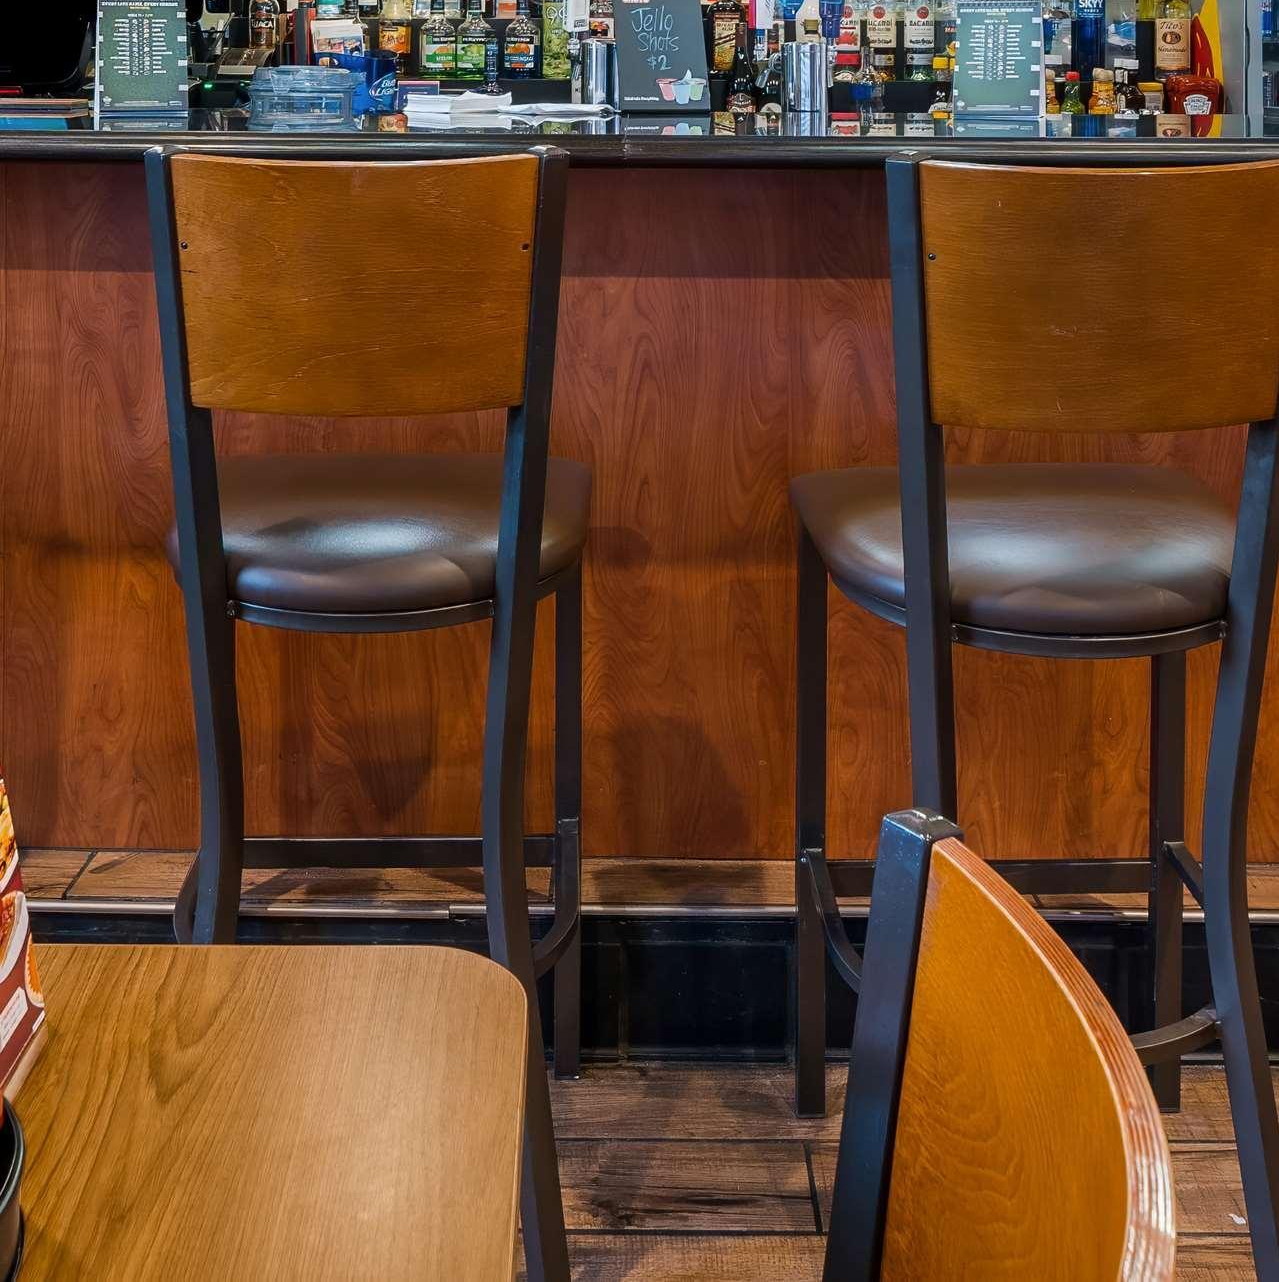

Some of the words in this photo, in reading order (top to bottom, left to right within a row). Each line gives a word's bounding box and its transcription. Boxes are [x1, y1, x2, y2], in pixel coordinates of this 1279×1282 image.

[630, 5, 674, 33] Jello
[637, 29, 680, 52] Shots
[647, 53, 673, 71] $2
